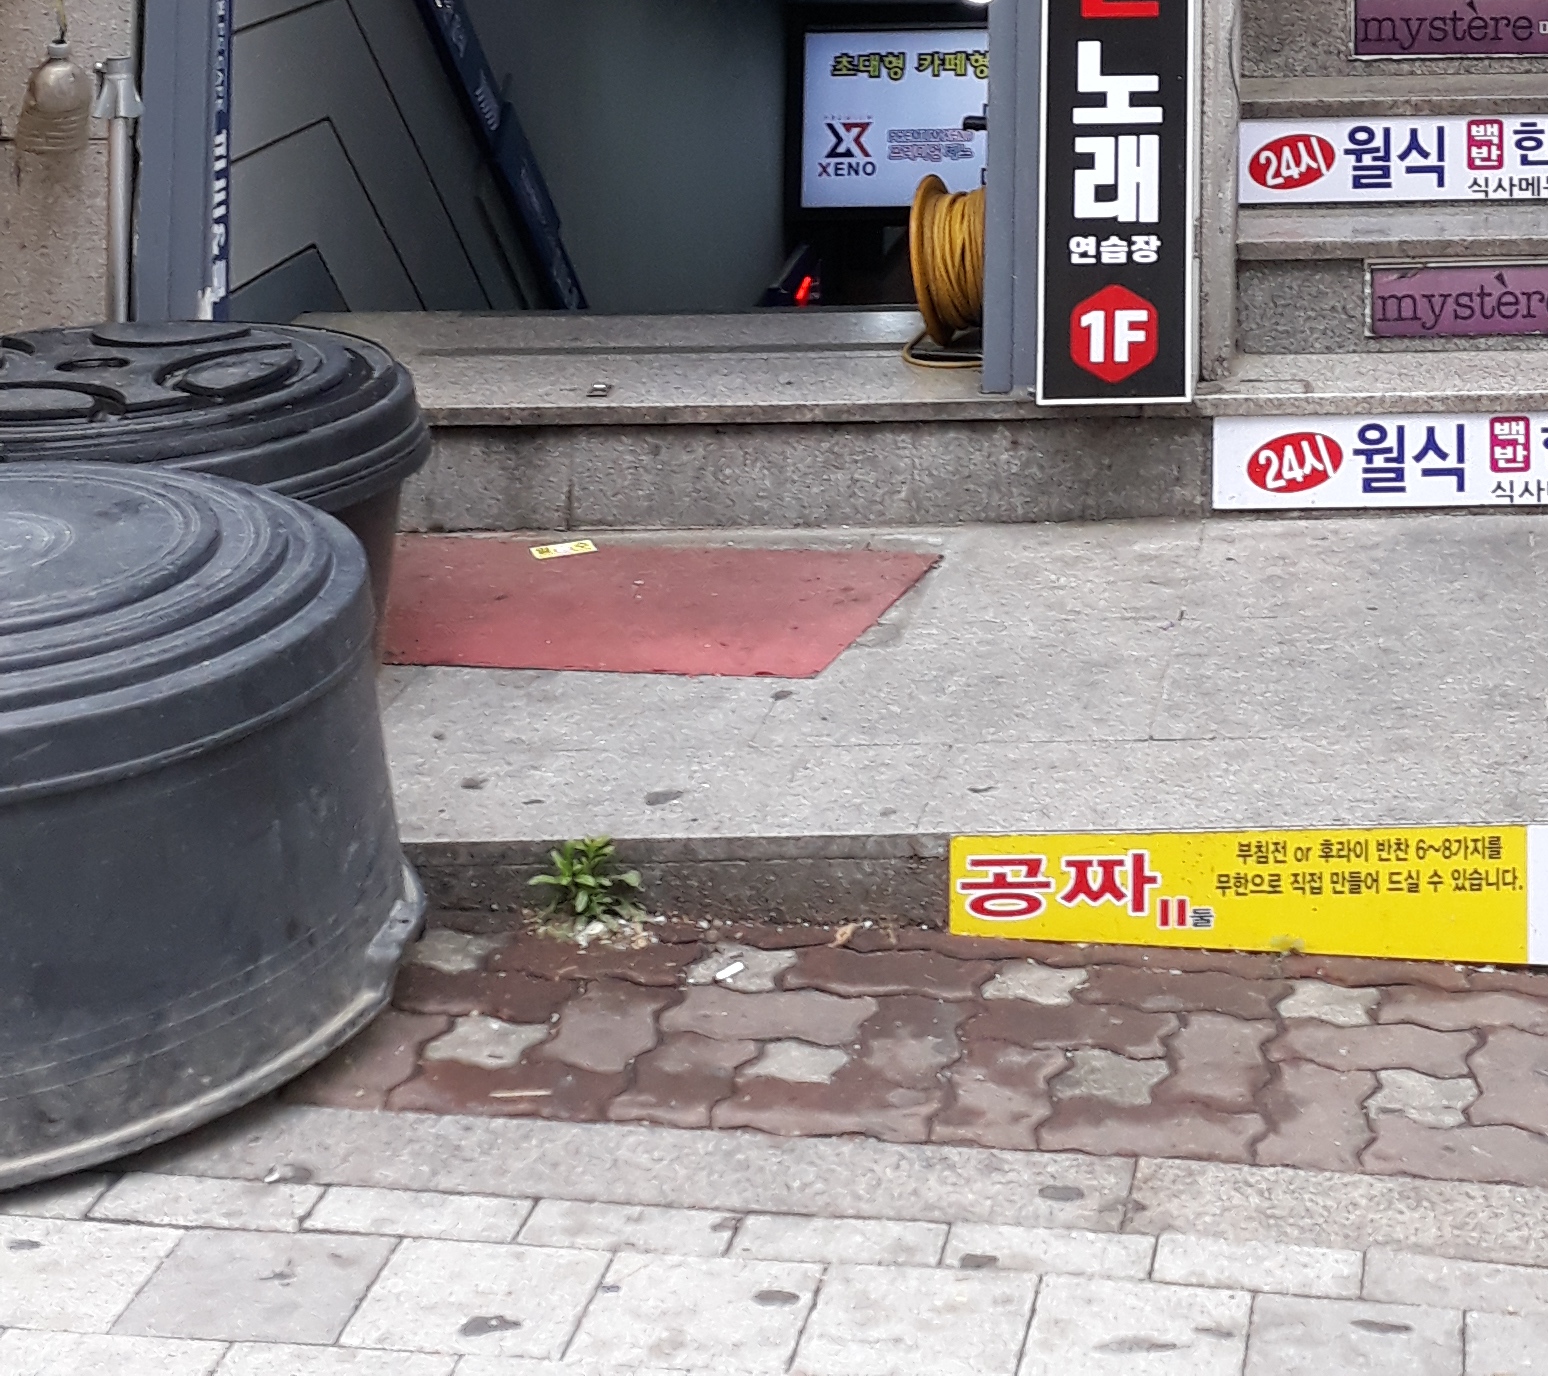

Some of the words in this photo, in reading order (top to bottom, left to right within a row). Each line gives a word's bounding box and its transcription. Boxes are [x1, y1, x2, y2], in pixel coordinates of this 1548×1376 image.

[830, 52, 905, 80] 초대형
[1072, 39, 1165, 223] 노래
[1470, 123, 1500, 167] 백반
[818, 161, 876, 177] XENO
[1259, 136, 1329, 186] 24시
[1343, 124, 1446, 189] 월식
[1069, 235, 1161, 265] 연습장
[1079, 309, 1149, 363] 1F
[1257, 440, 1338, 488] 24시
[1352, 423, 1466, 493] 월식
[1492, 420, 1529, 469] 백반
[1294, 846, 1311, 862] or
[1376, 837, 1410, 861] 반찬
[960, 852, 1158, 917] 공짜
[1216, 873, 1282, 896] 무한으로
[1290, 872, 1323, 895] 직접
[1330, 871, 1380, 893] 만들어
[1387, 870, 1420, 892] 드실
[1426, 870, 1444, 893] 수
[1452, 868, 1523, 892] 있습니다.
